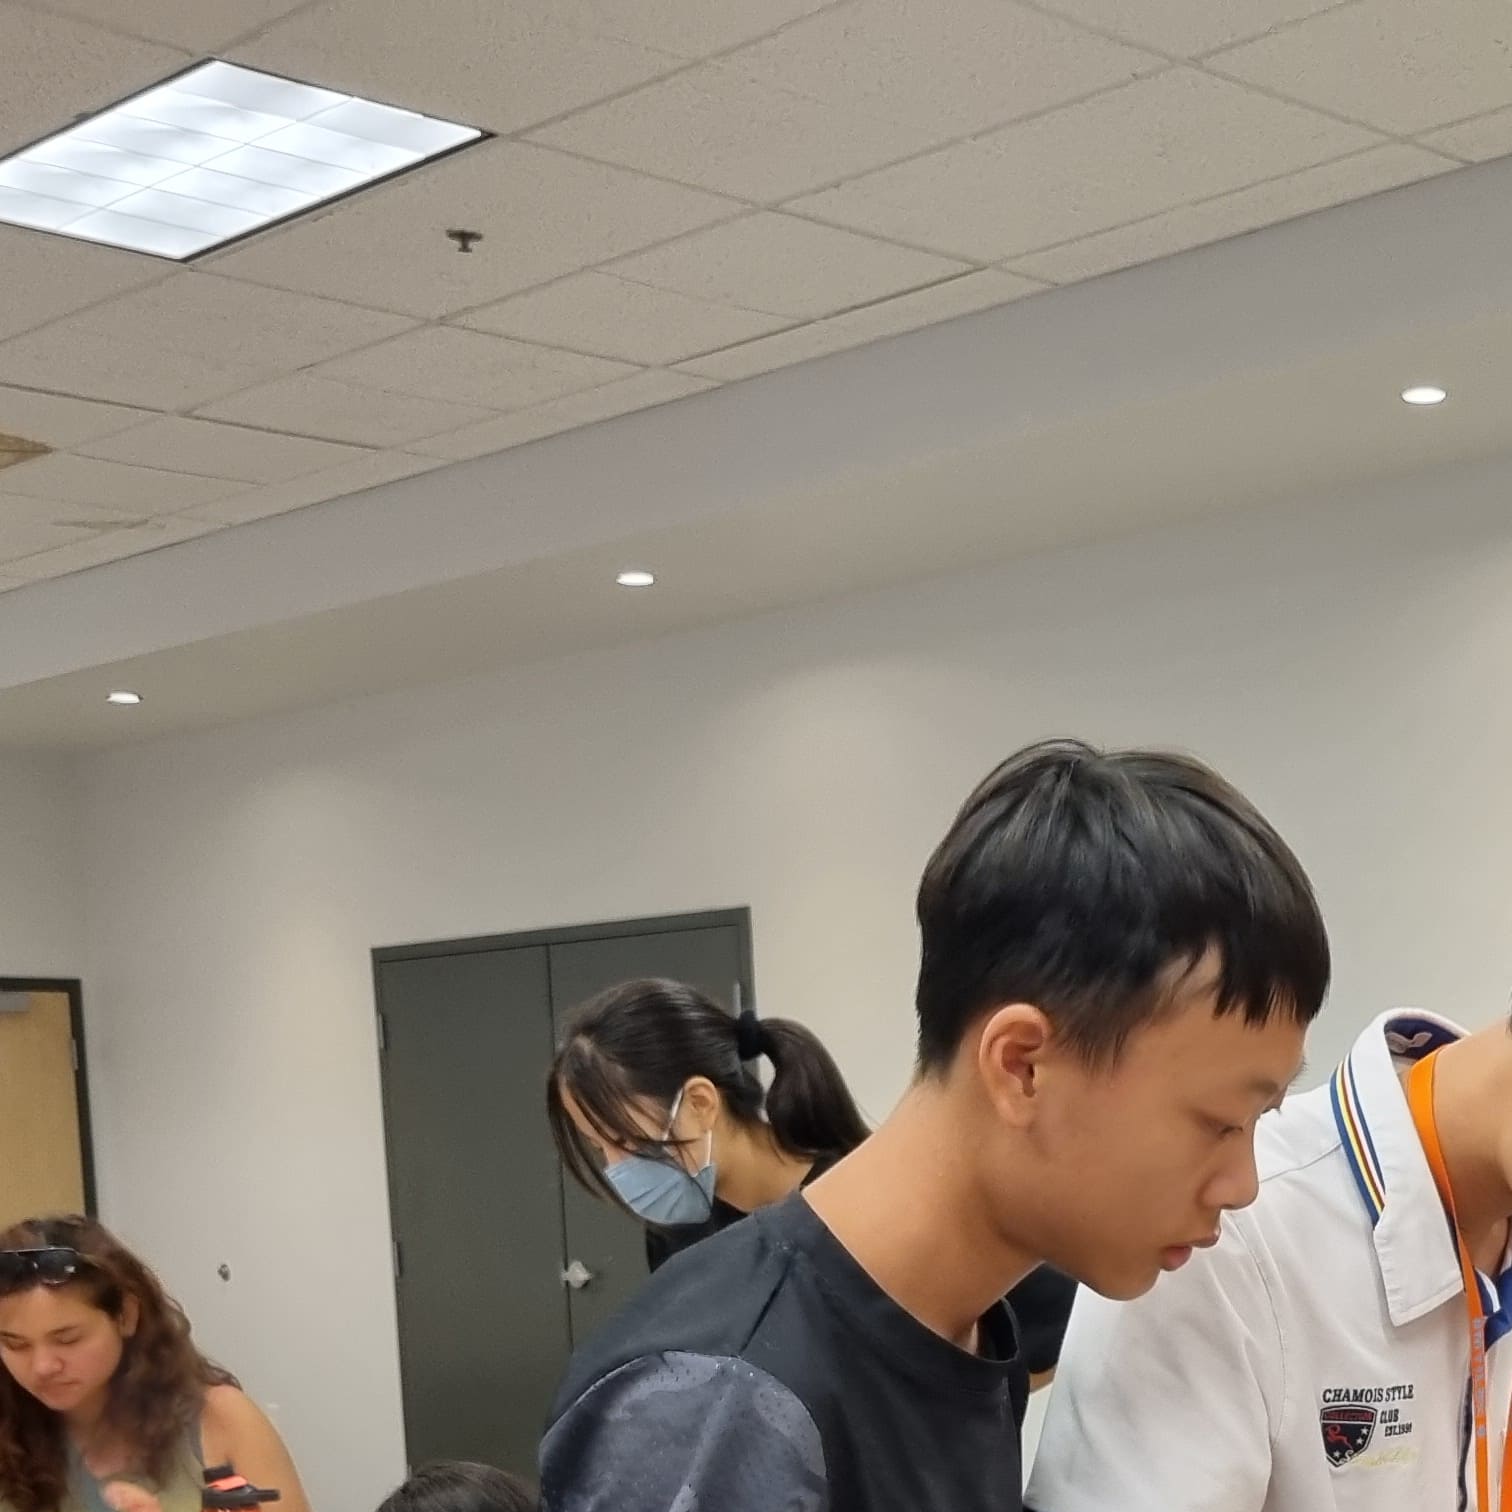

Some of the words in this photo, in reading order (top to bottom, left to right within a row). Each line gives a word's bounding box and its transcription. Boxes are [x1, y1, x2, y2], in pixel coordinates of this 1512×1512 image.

[1322, 1387, 1383, 1403] CHAMOIS
[1385, 1384, 1414, 1402] STYLE
[1379, 1408, 1399, 1424] CLUB
